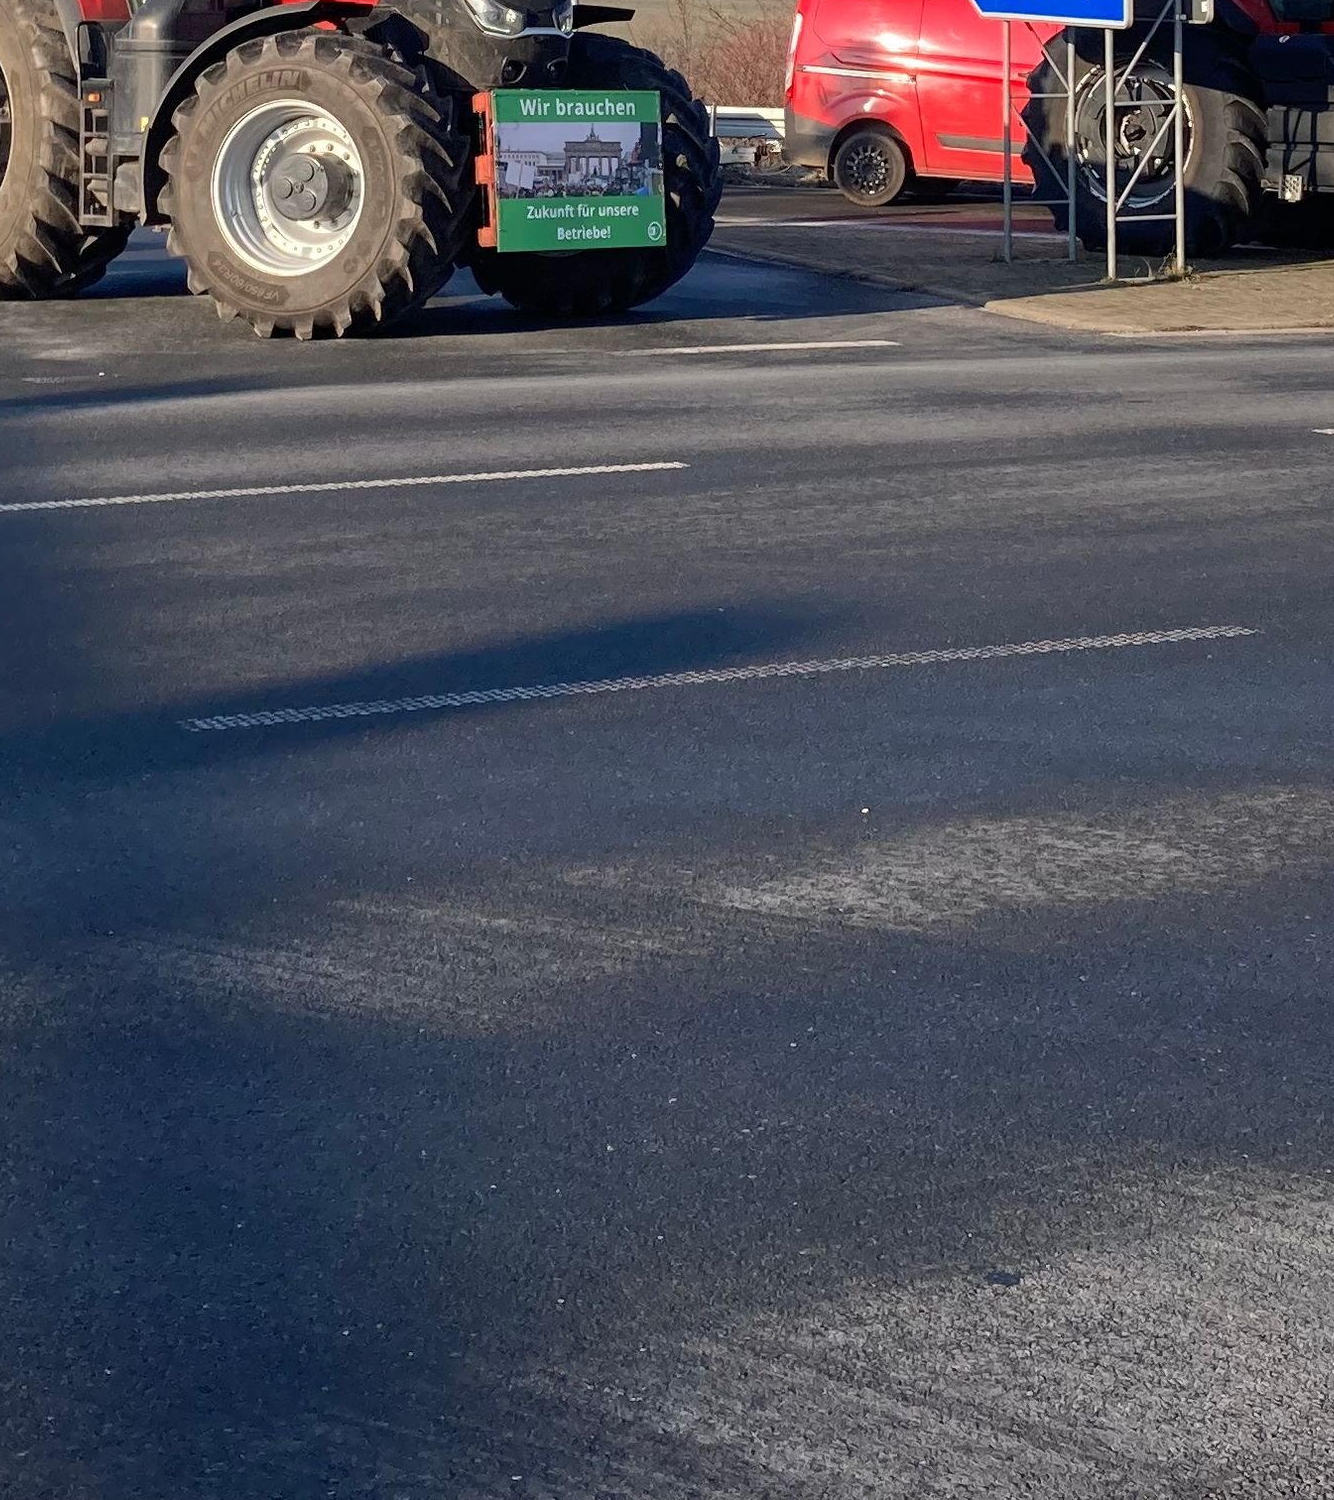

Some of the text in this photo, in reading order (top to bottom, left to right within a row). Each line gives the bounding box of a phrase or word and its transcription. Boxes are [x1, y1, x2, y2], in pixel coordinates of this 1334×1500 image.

[520, 98, 636, 116] Wir brauchen
[527, 203, 639, 220] Zukunft für unsere
[557, 225, 611, 240] Betriebe!
